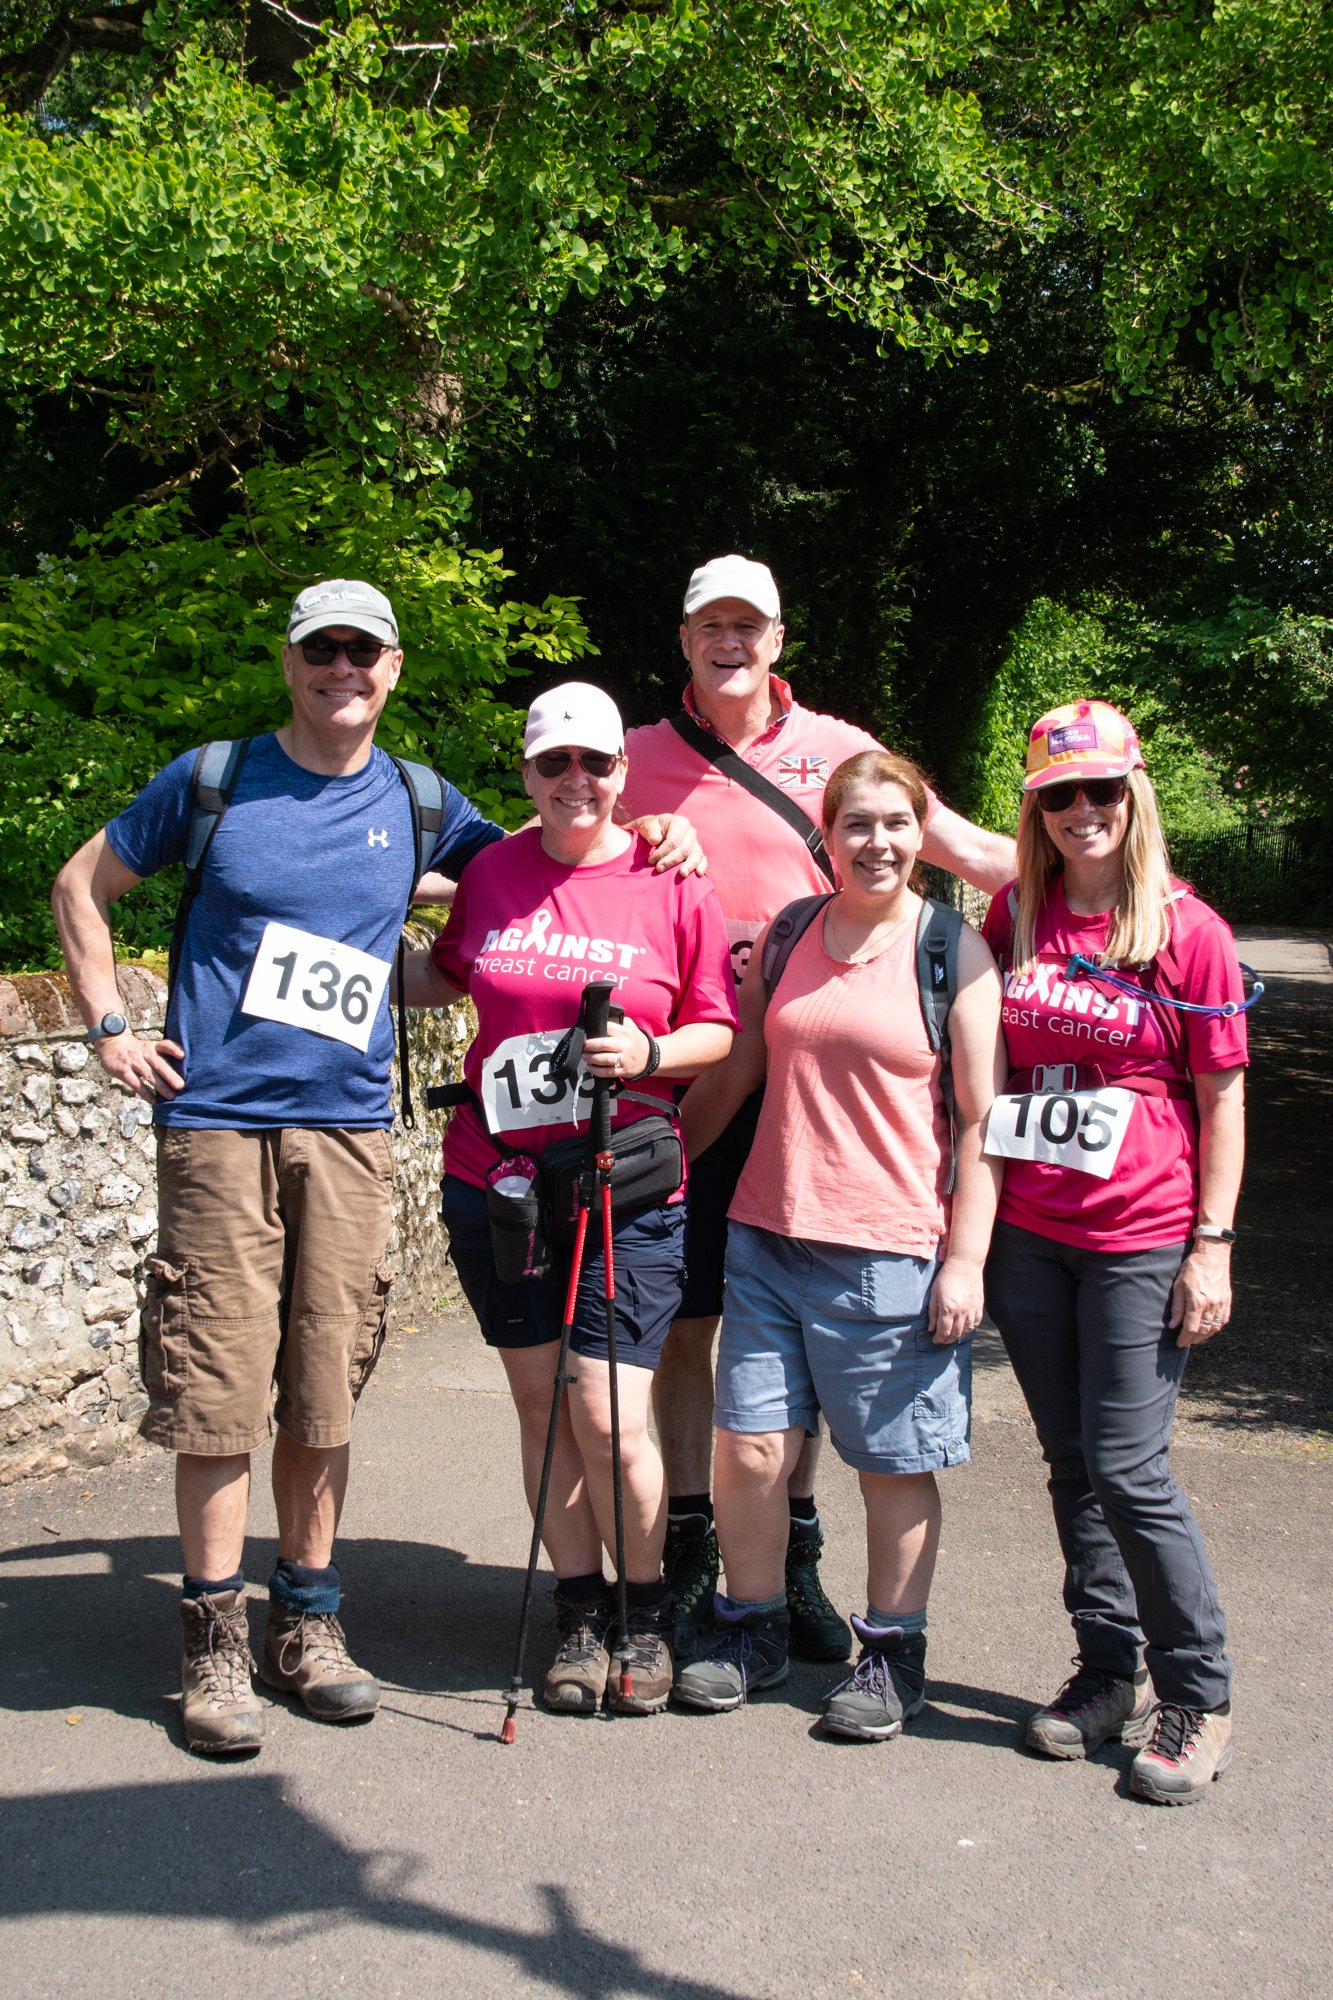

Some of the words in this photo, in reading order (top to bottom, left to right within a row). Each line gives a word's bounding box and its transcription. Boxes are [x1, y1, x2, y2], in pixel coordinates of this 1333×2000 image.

[272, 951, 373, 1025] 136
[473, 955, 537, 977] breast
[544, 962, 629, 990] cancer
[1002, 1005, 1040, 1029] east
[1048, 1015, 1136, 1048] cancer
[1009, 1094, 1118, 1152] 105
